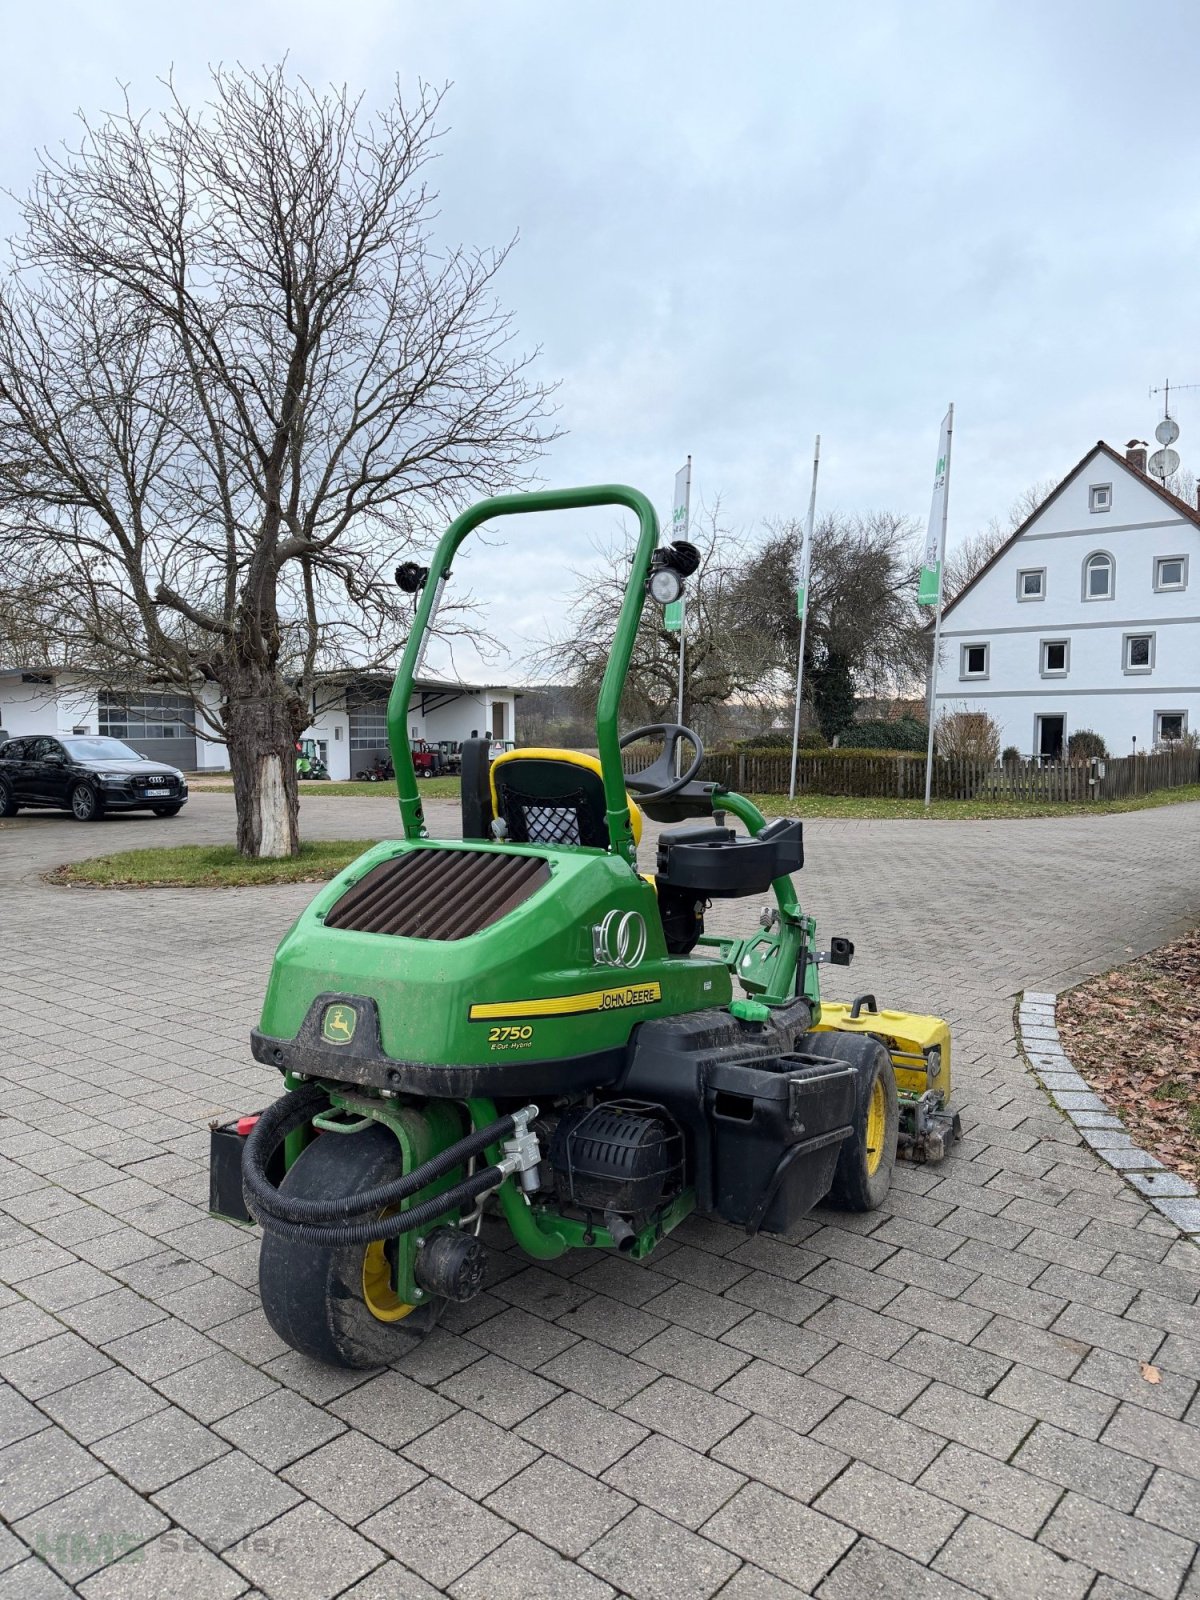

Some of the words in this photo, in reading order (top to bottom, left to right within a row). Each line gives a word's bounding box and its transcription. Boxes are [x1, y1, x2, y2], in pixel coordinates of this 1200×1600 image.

[599, 992, 624, 1009] JOHN
[626, 989, 655, 1005] DEERE
[488, 1025, 533, 1042] 2750
[510, 1041, 532, 1050] Hybrid
